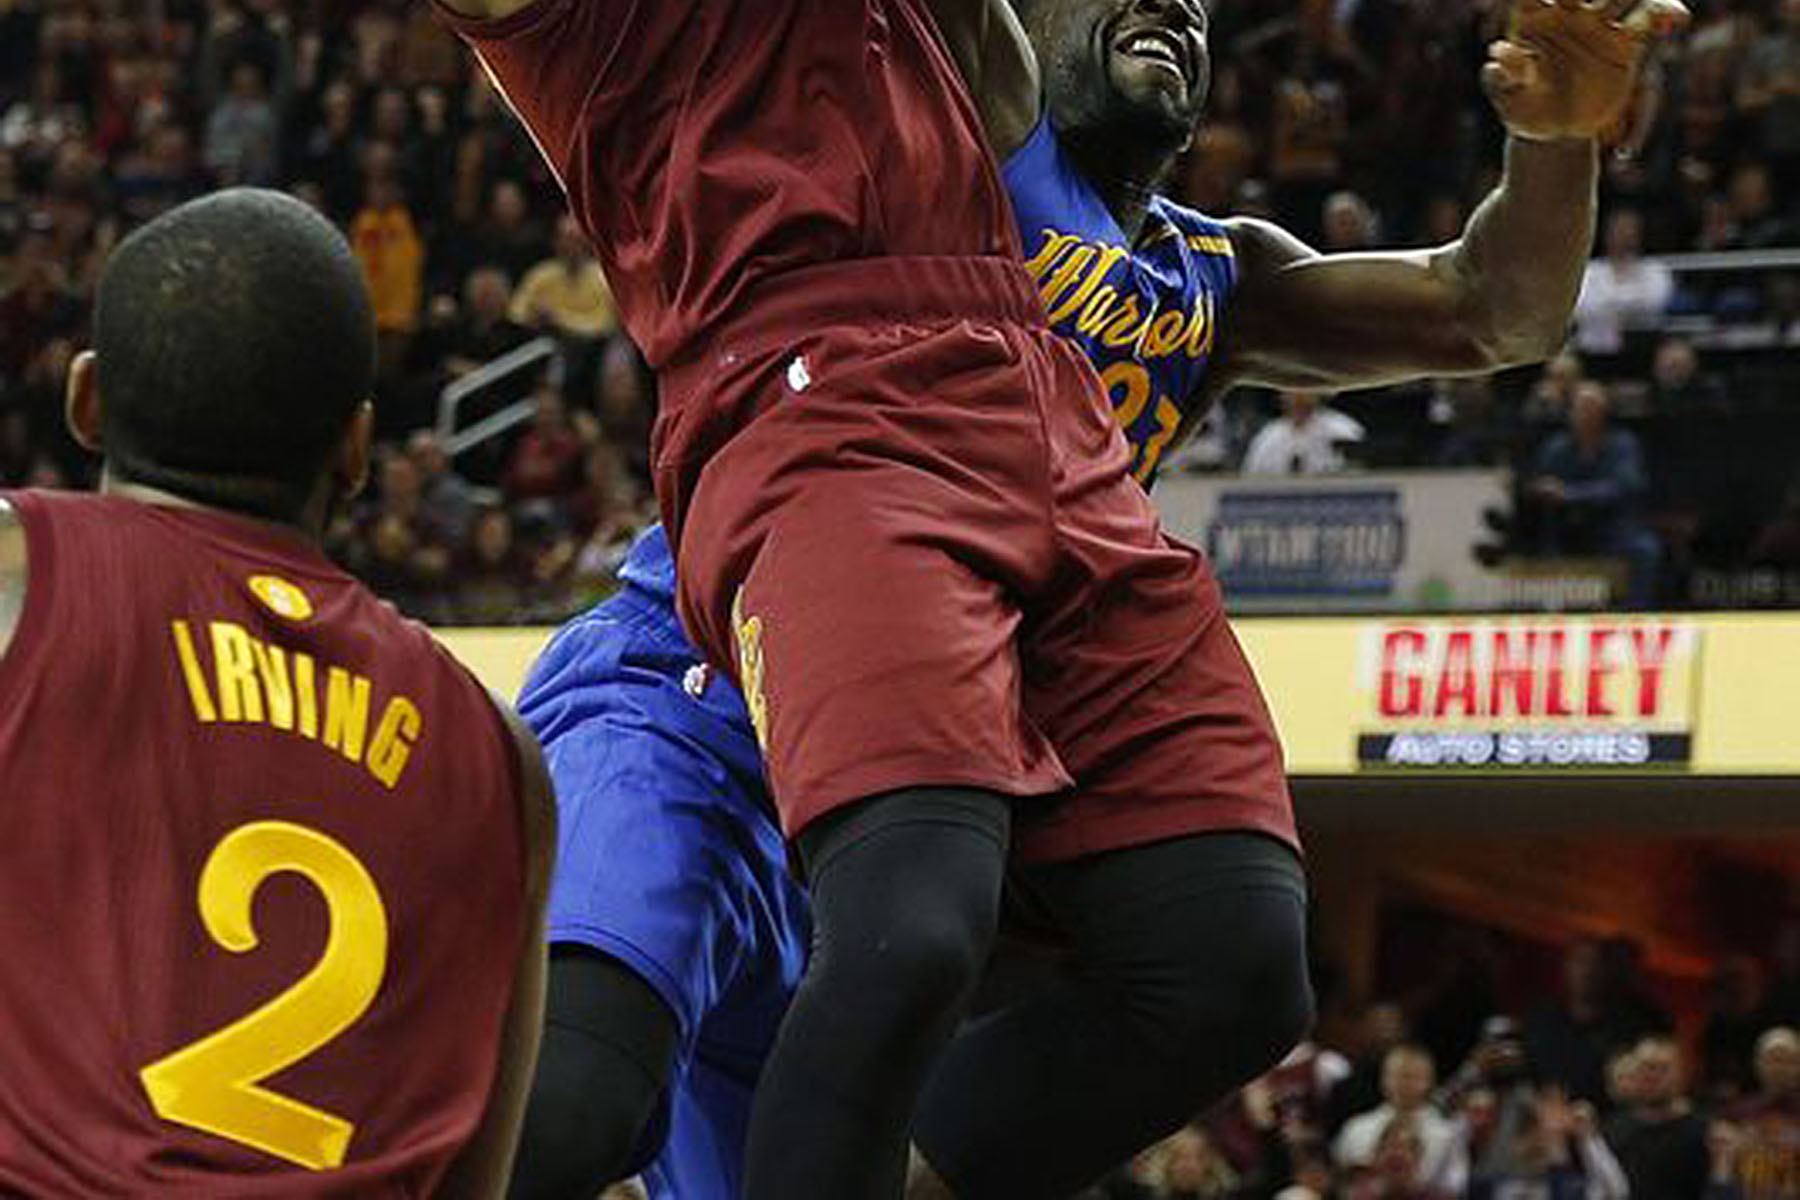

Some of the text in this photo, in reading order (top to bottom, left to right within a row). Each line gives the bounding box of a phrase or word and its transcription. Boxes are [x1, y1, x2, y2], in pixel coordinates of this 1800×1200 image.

[172, 620, 421, 789] IRVING
[1379, 629, 1672, 717] GANLEY
[140, 820, 388, 1171] 2
